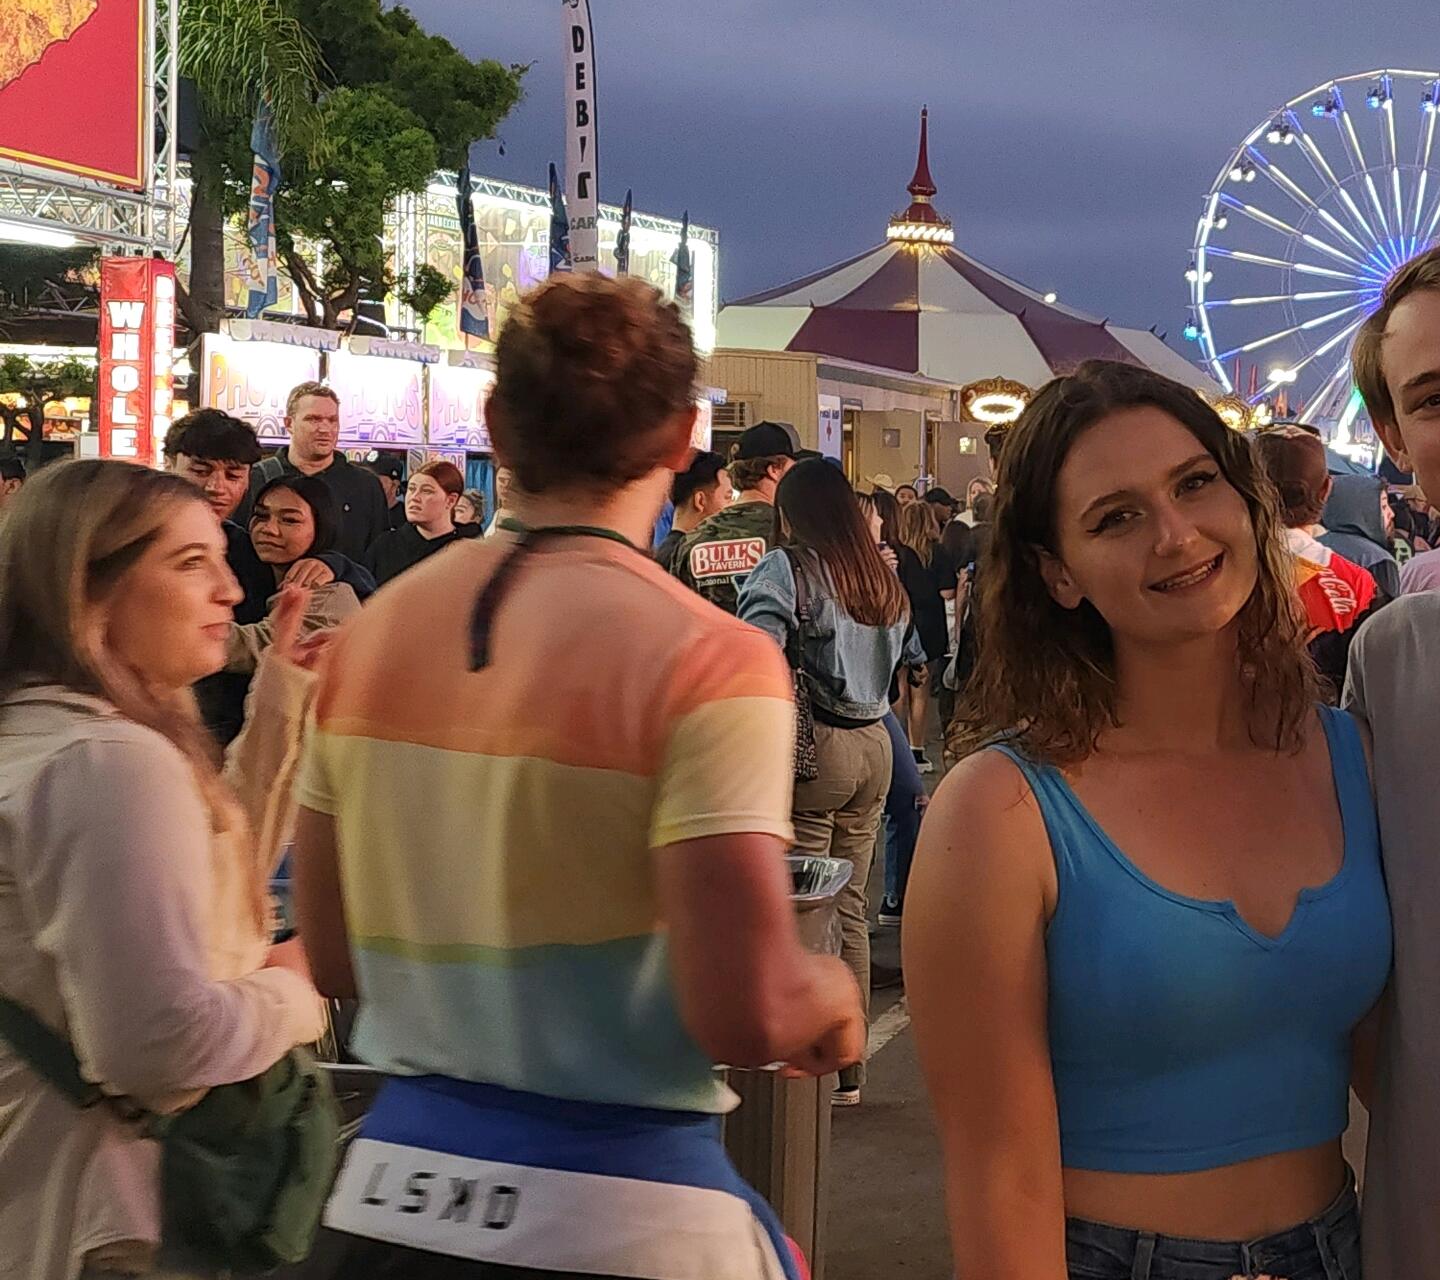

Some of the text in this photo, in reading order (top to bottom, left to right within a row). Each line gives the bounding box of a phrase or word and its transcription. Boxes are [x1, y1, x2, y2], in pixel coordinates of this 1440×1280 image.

[97, 301, 146, 457] WHOLE
[694, 541, 762, 573] BULL'S
[710, 560, 746, 571] TAVERN
